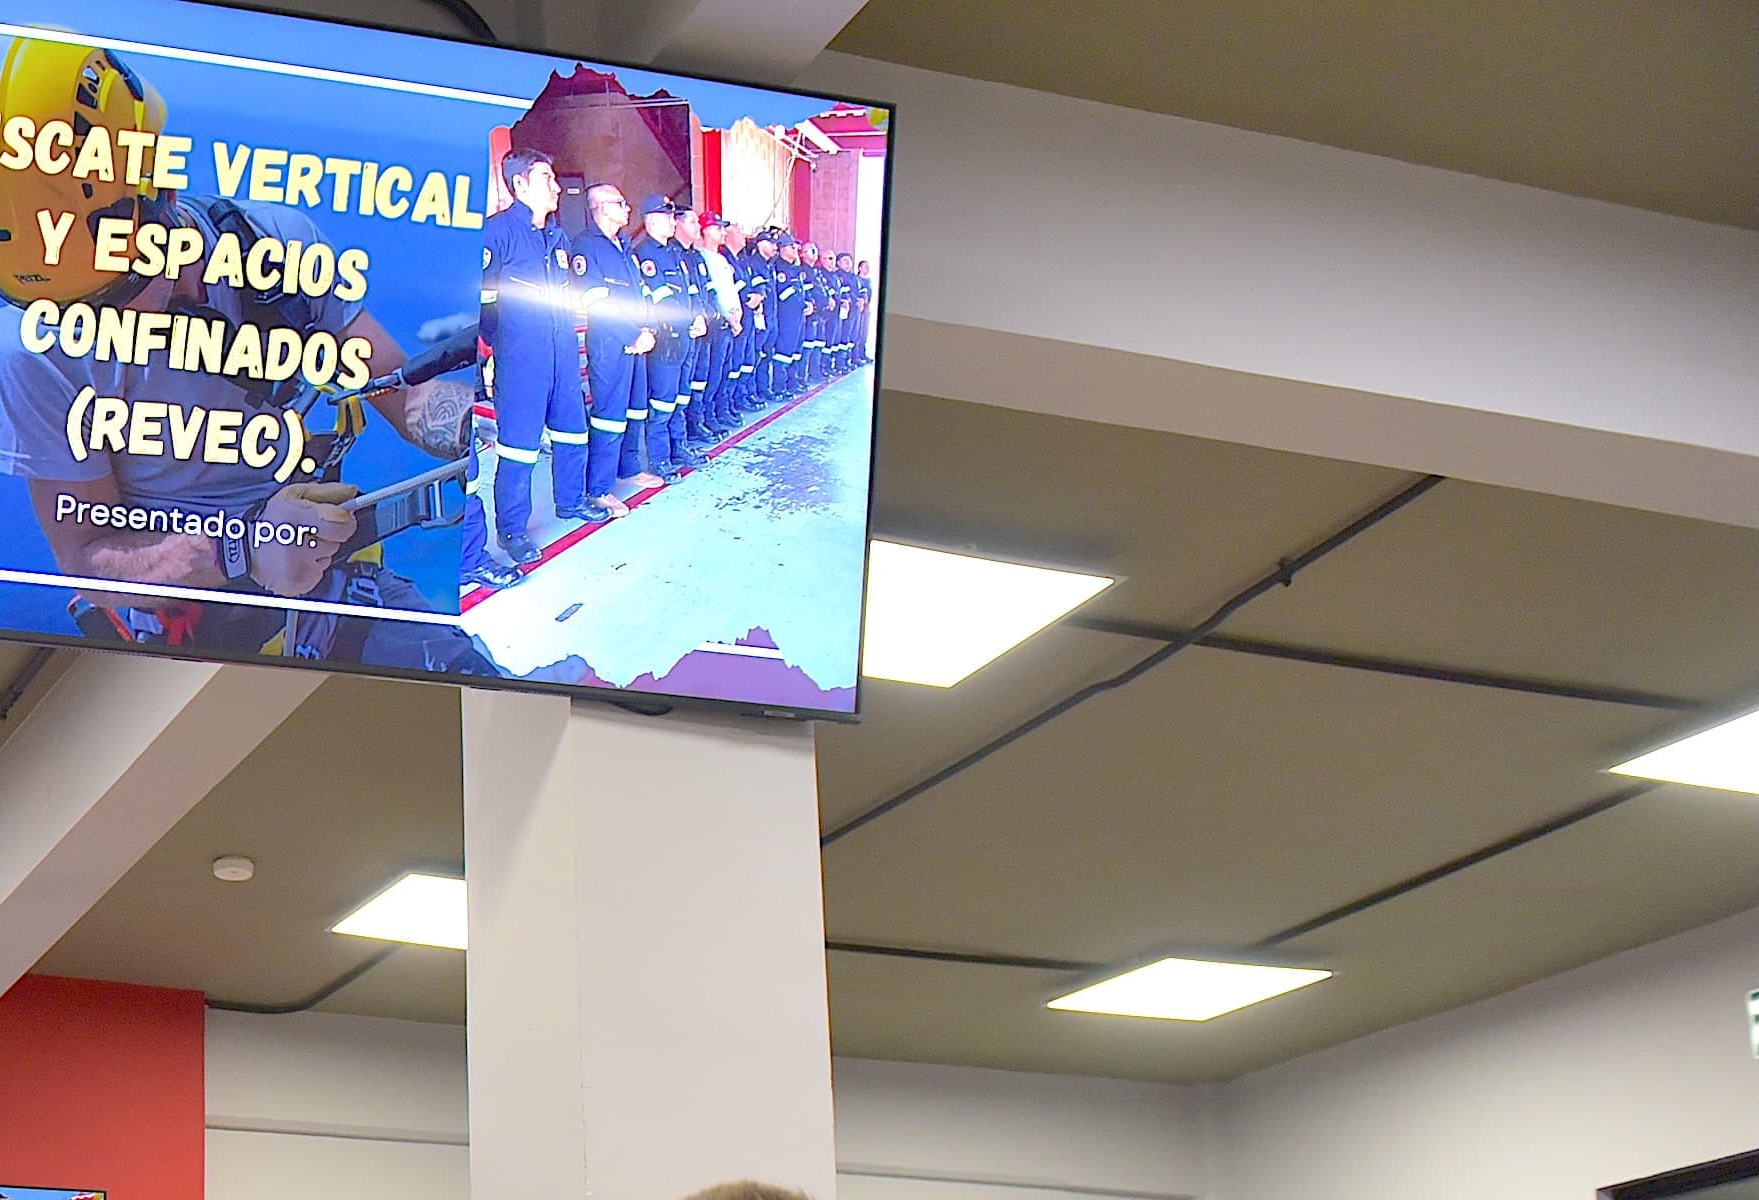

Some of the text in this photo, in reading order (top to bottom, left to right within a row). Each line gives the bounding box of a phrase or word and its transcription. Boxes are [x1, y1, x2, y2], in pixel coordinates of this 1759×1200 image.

[212, 141, 484, 230] VERTICAL
[36, 209, 369, 302] Y ESPACIOS
[19, 297, 373, 390] CONFINADOS
[66, 385, 316, 483] (REVEC).
[55, 494, 318, 548] Presentado por:
